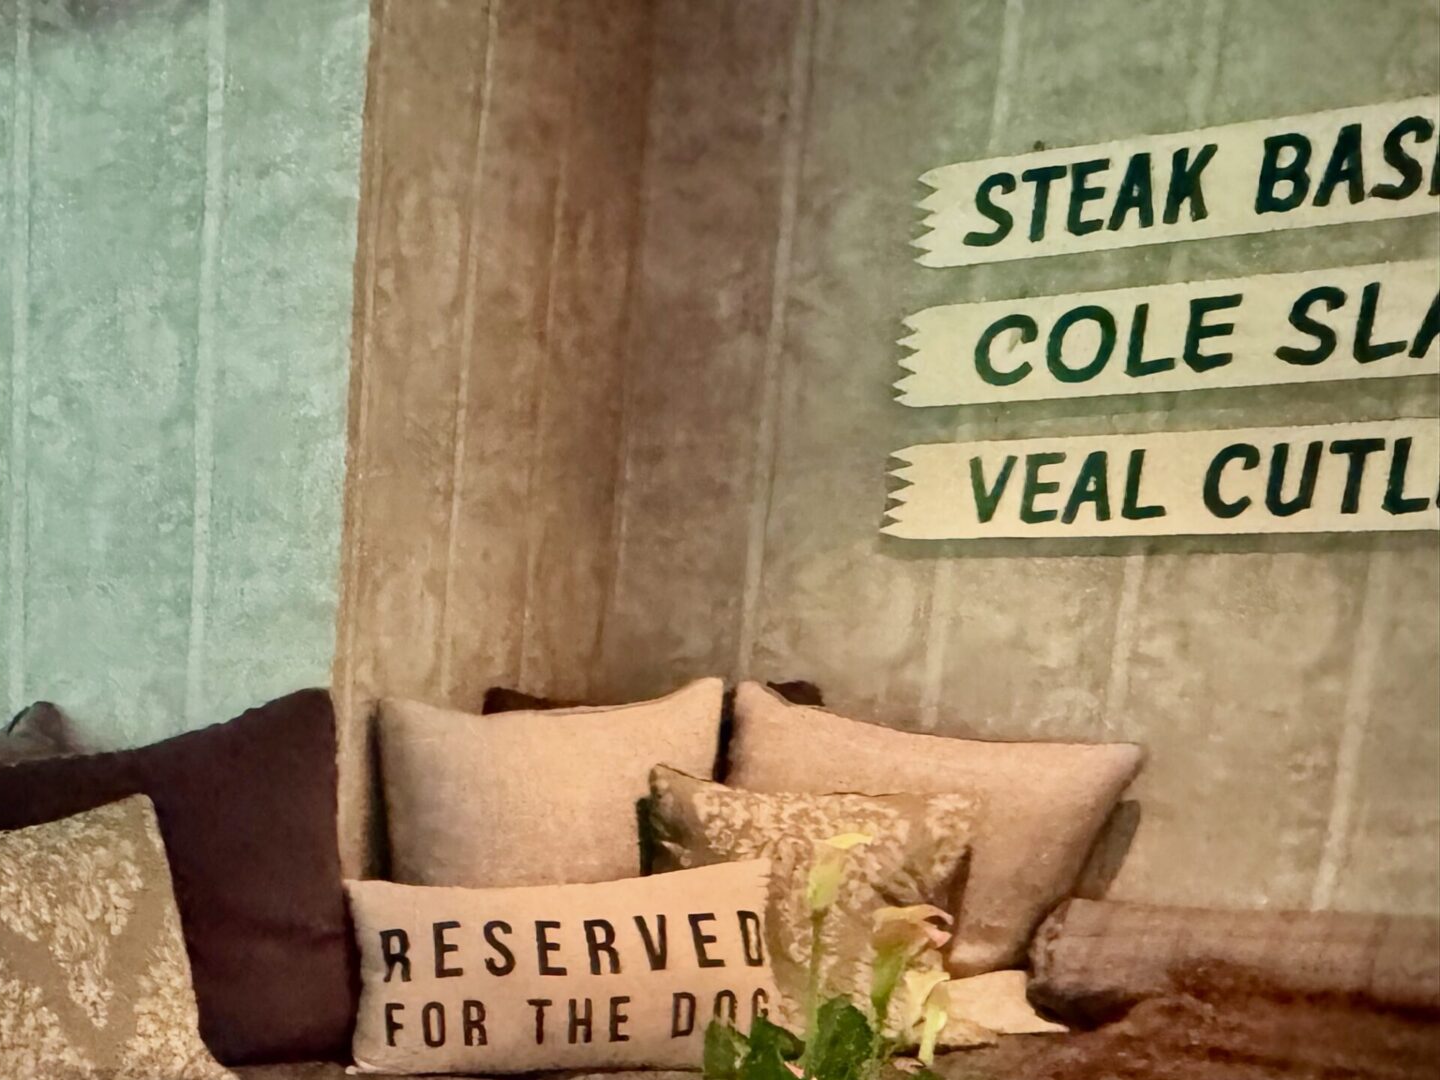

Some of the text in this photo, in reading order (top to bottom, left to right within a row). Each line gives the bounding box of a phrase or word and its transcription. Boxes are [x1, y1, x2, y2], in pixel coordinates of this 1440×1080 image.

[962, 142, 1219, 247] STEAK
[973, 293, 1243, 386] COLE
[969, 448, 1167, 524] VEAL
[379, 908, 766, 982] RESERVED
[384, 999, 489, 1048] FOR
[527, 994, 631, 1045] THE
